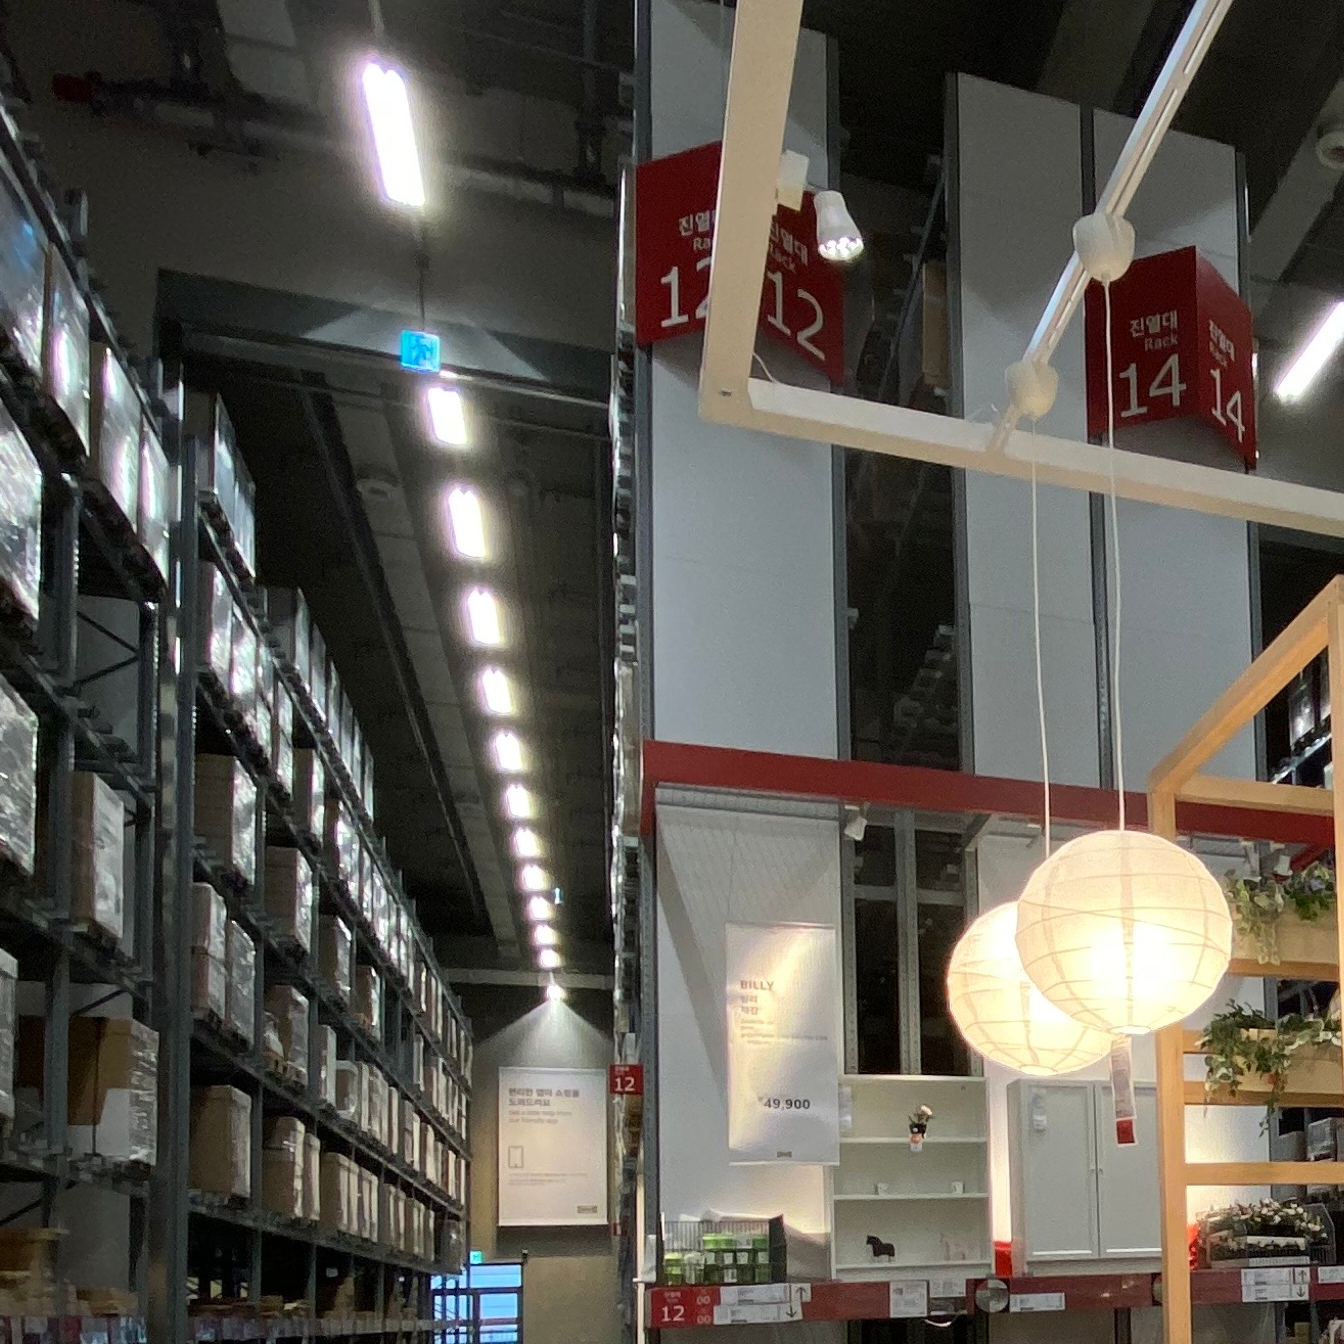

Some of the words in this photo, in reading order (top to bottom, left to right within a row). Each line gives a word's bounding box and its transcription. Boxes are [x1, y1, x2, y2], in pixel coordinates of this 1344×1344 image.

[678, 210, 716, 236] 진열
[692, 237, 711, 252] Ra
[766, 270, 826, 361] 12
[1130, 309, 1178, 338] 진열대
[1144, 332, 1178, 352] Rack
[1119, 353, 1187, 418] 14
[1210, 368, 1246, 443] 14
[740, 980, 774, 991] BILLY
[614, 1076, 635, 1092] 12
[661, 1305, 685, 1322] 12
